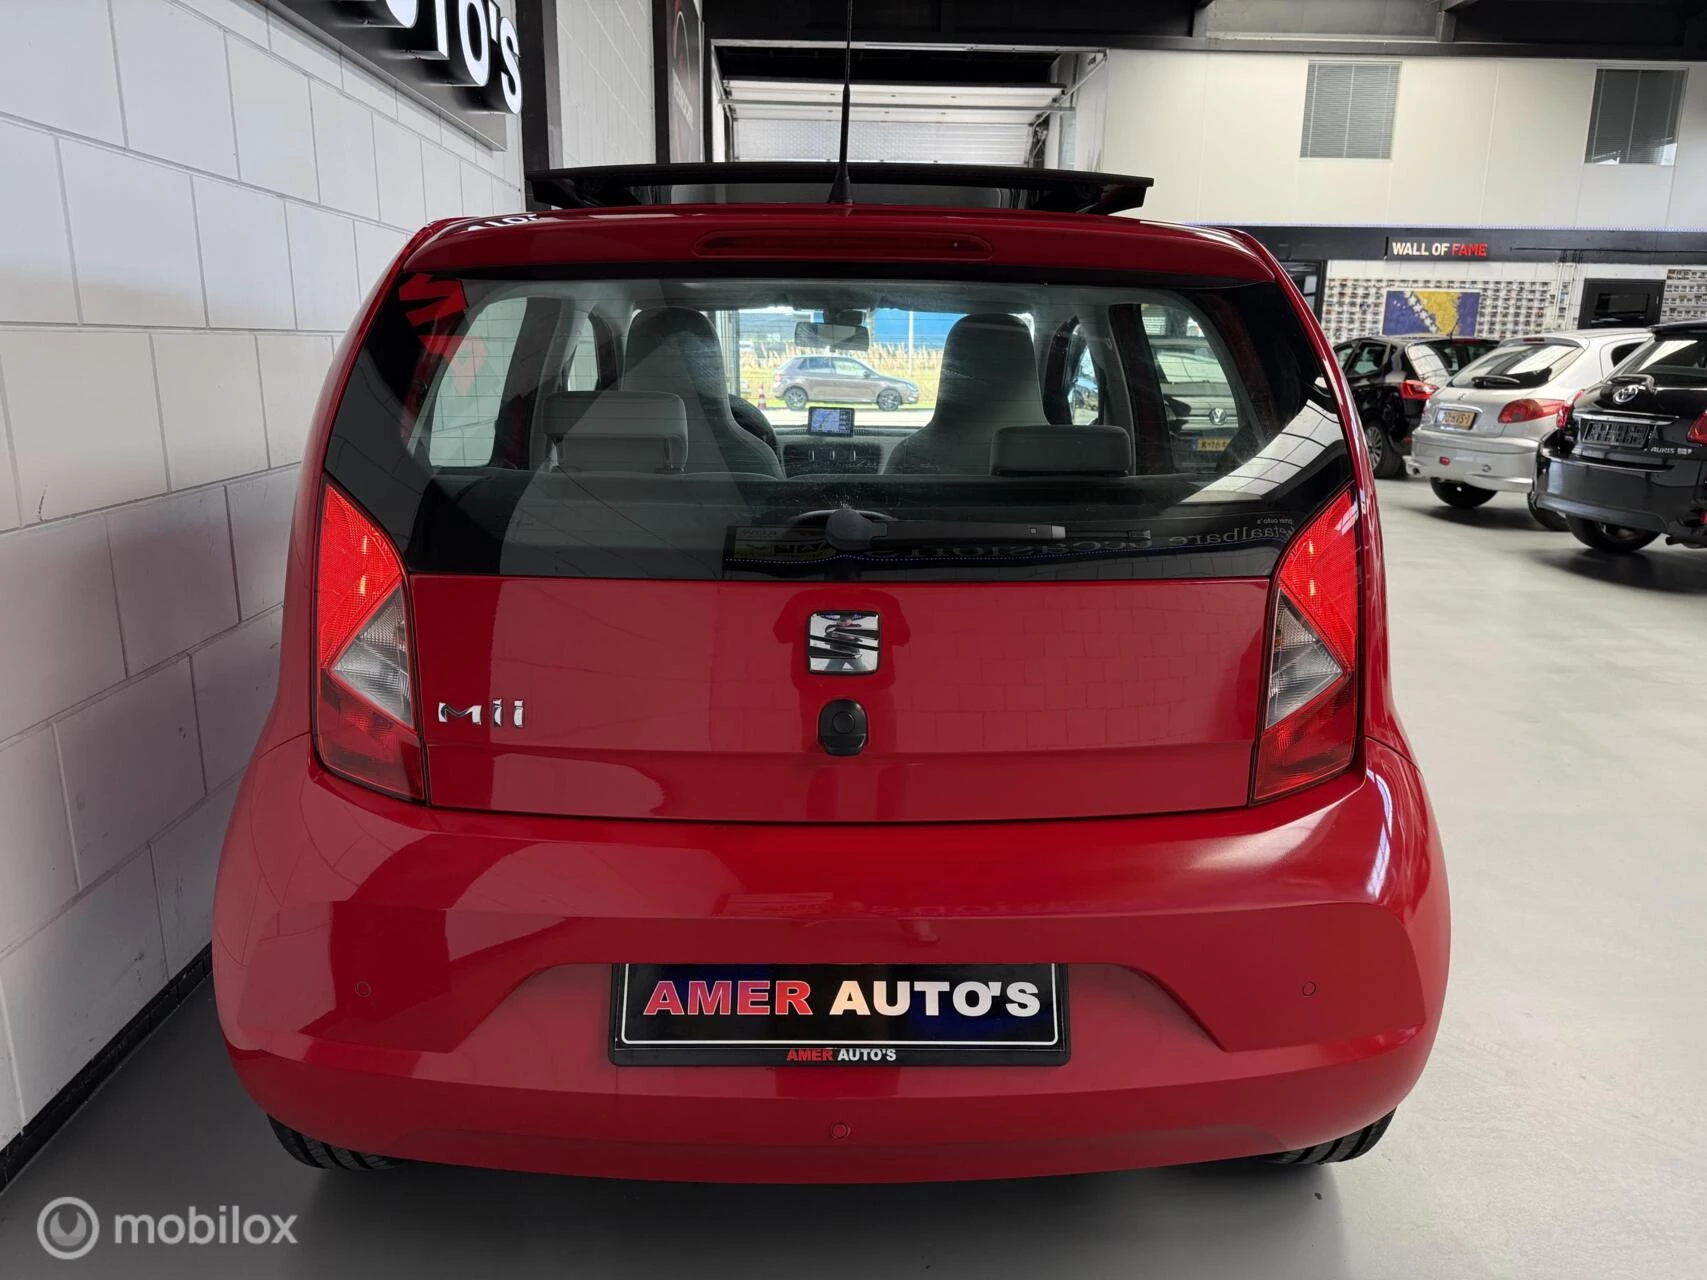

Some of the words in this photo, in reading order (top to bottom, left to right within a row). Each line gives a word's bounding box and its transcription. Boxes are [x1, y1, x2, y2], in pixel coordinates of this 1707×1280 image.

[386, 0, 522, 114] O'S
[1392, 242, 1429, 255] WALL
[1432, 242, 1450, 256] OF
[1451, 243, 1489, 257] FAME
[438, 698, 524, 728] Mii
[643, 980, 814, 1016] AMER
[829, 980, 1041, 1017] AUTO'S
[787, 1048, 833, 1061] AMER
[837, 1048, 897, 1062] AUTO'S
